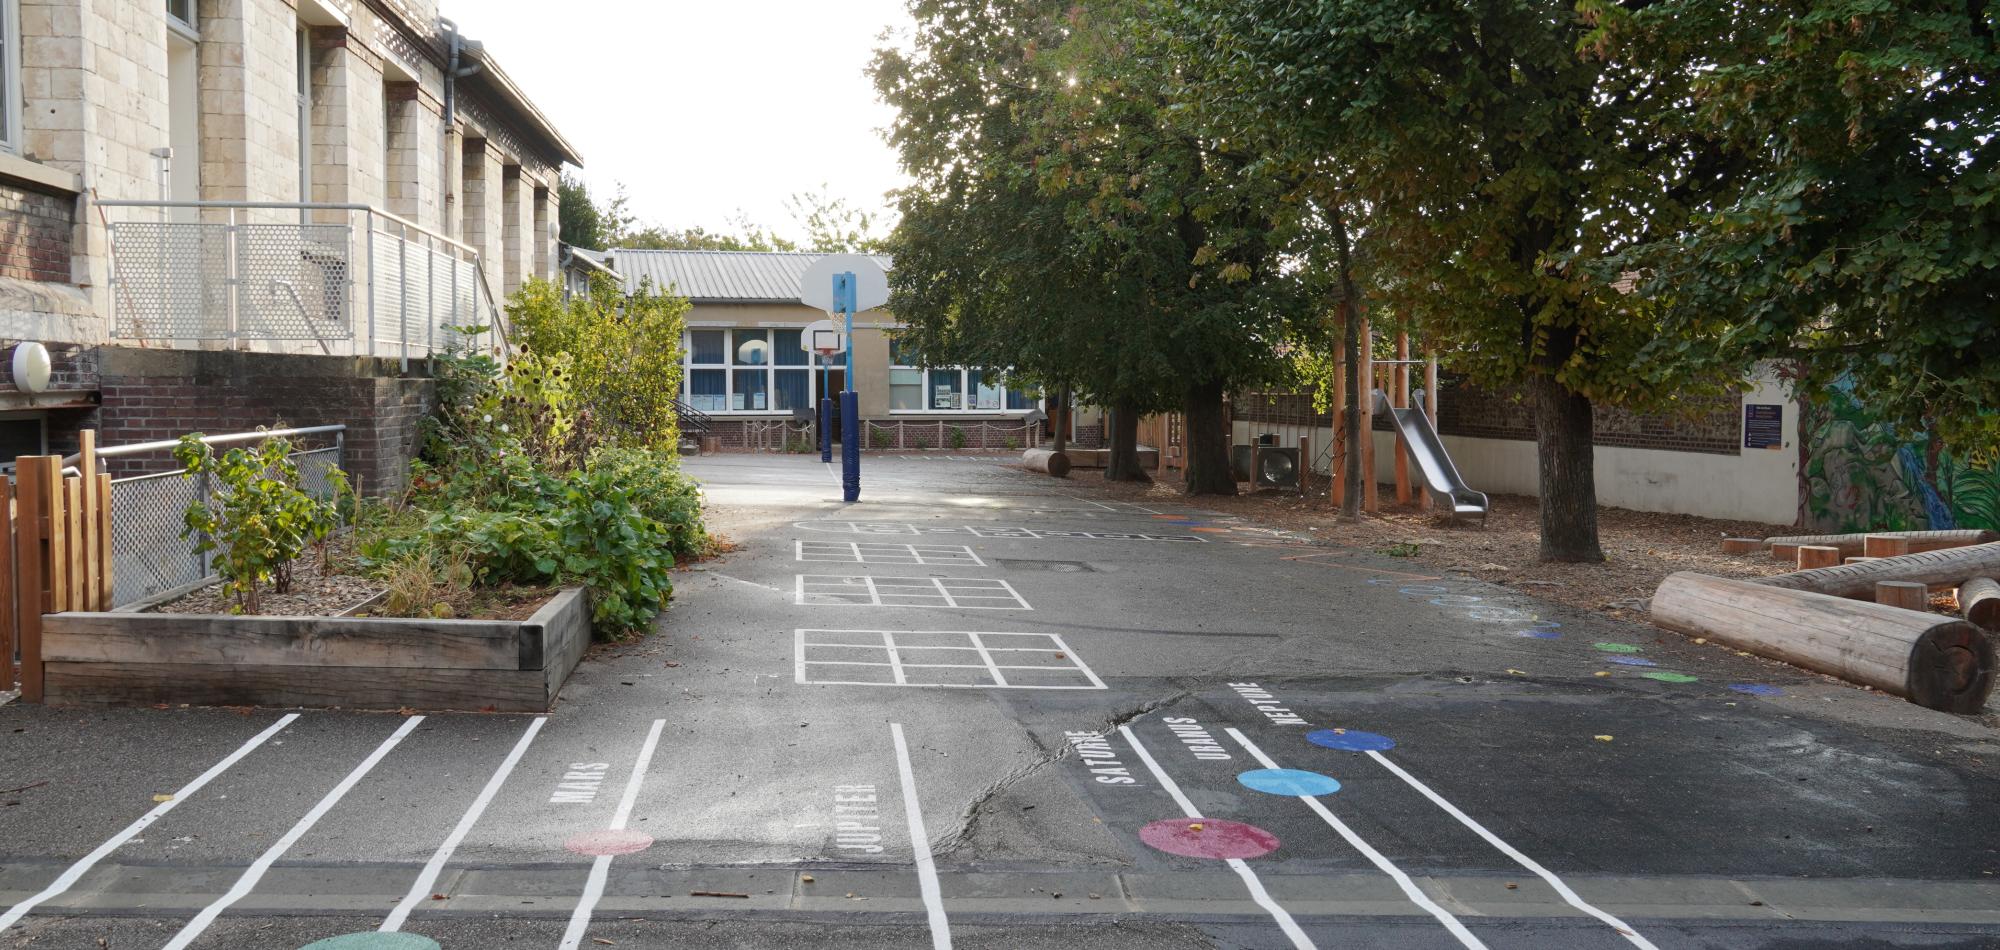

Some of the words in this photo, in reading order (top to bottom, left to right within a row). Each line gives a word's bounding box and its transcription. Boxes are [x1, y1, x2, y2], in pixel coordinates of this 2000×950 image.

[1228, 682, 1312, 725] NEPTUNE
[1064, 730, 1136, 785] SATURNE
[1163, 717, 1231, 760] URANUS
[550, 762, 609, 803] MARS
[835, 784, 883, 854] JUPITER
